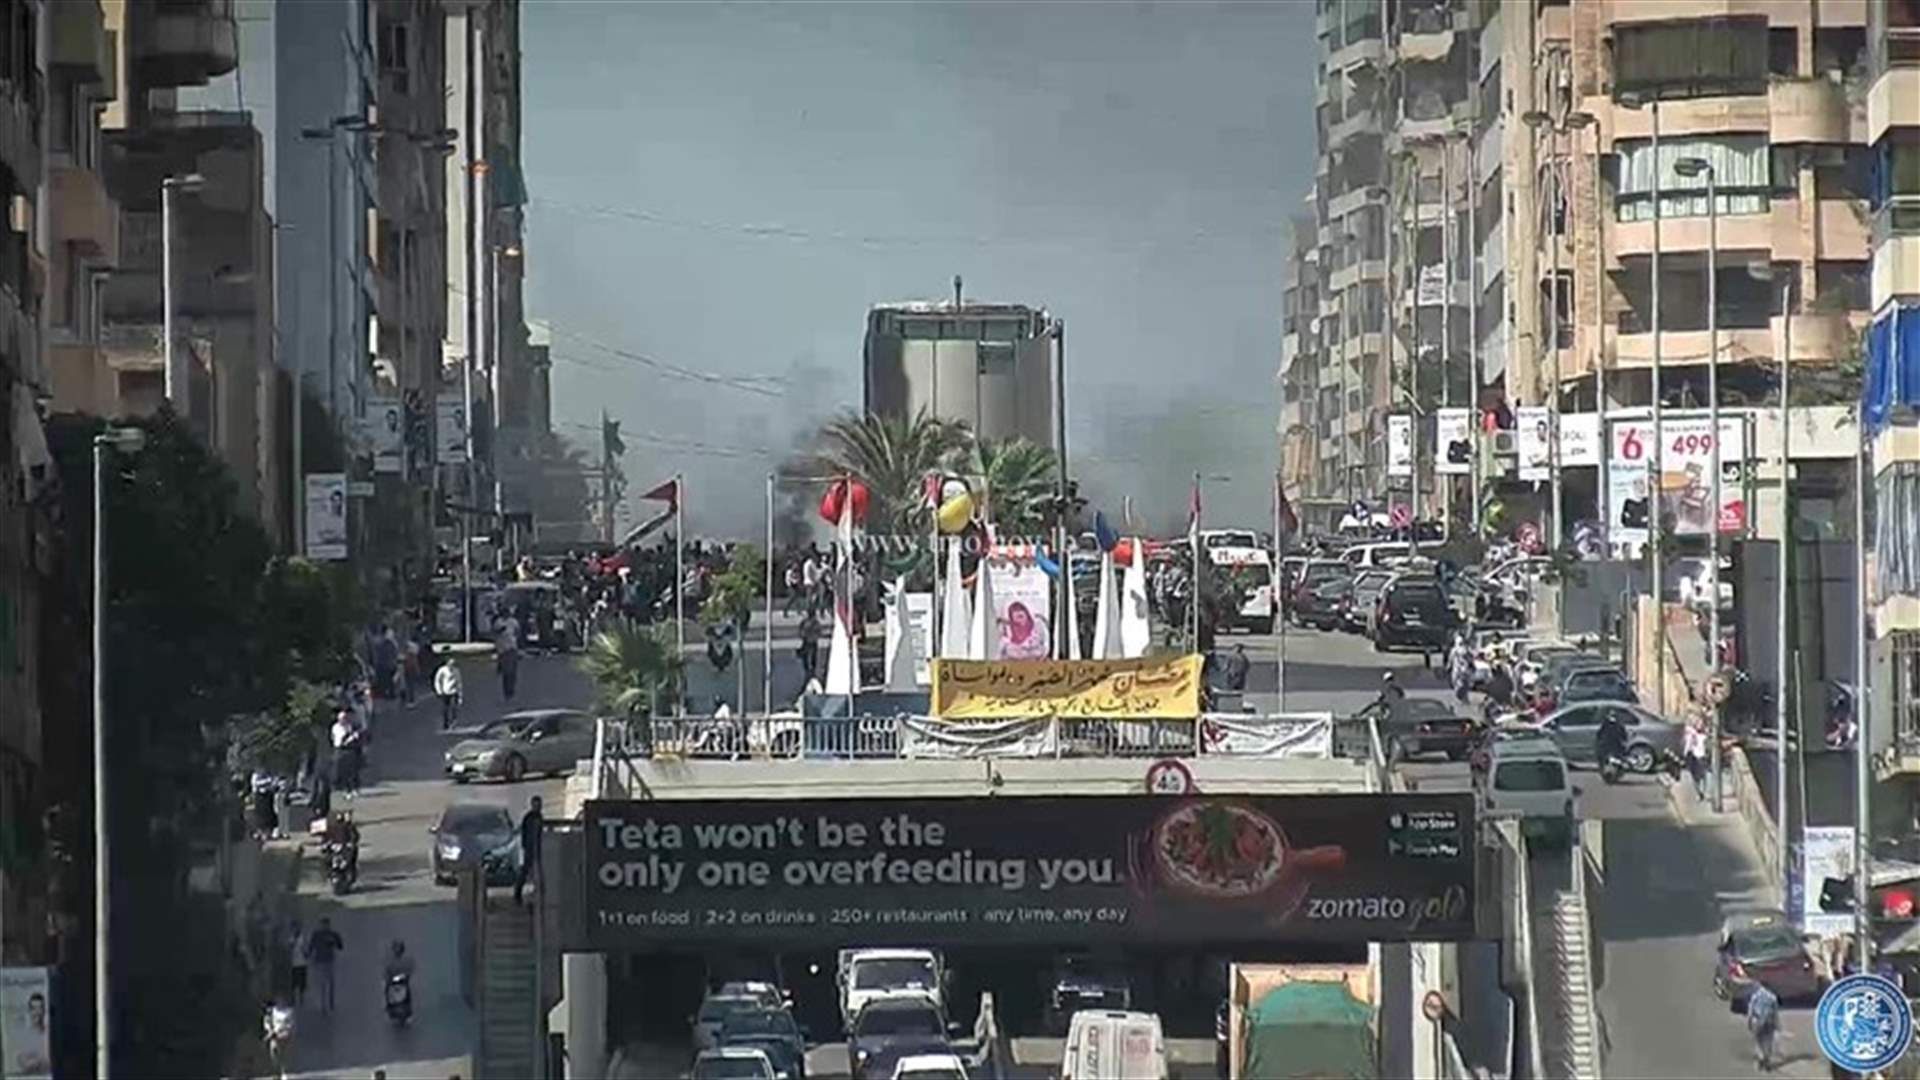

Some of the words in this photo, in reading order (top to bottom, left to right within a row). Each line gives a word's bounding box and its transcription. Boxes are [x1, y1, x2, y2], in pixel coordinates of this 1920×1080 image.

[1622, 428, 1643, 460] 6
[599, 818, 682, 849] Teta
[693, 817, 804, 849] won't
[818, 817, 867, 848] be
[880, 814, 945, 846] the
[599, 854, 684, 892] only
[697, 861, 770, 886] one
[783, 849, 1026, 890] overfeeding
[1039, 858, 1124, 891] you.
[599, 910, 623, 925] 1+1
[627, 913, 648, 925] on
[651, 909, 690, 925] food
[706, 908, 737, 925] 2+2
[741, 911, 762, 924] on
[765, 908, 816, 925] drinks
[830, 908, 871, 924] 250+
[876, 908, 967, 924] restaurants
[983, 908, 1015, 924] any
[1062, 908, 1093, 924] any
[1096, 906, 1128, 924] day
[1306, 895, 1406, 920] zomato
